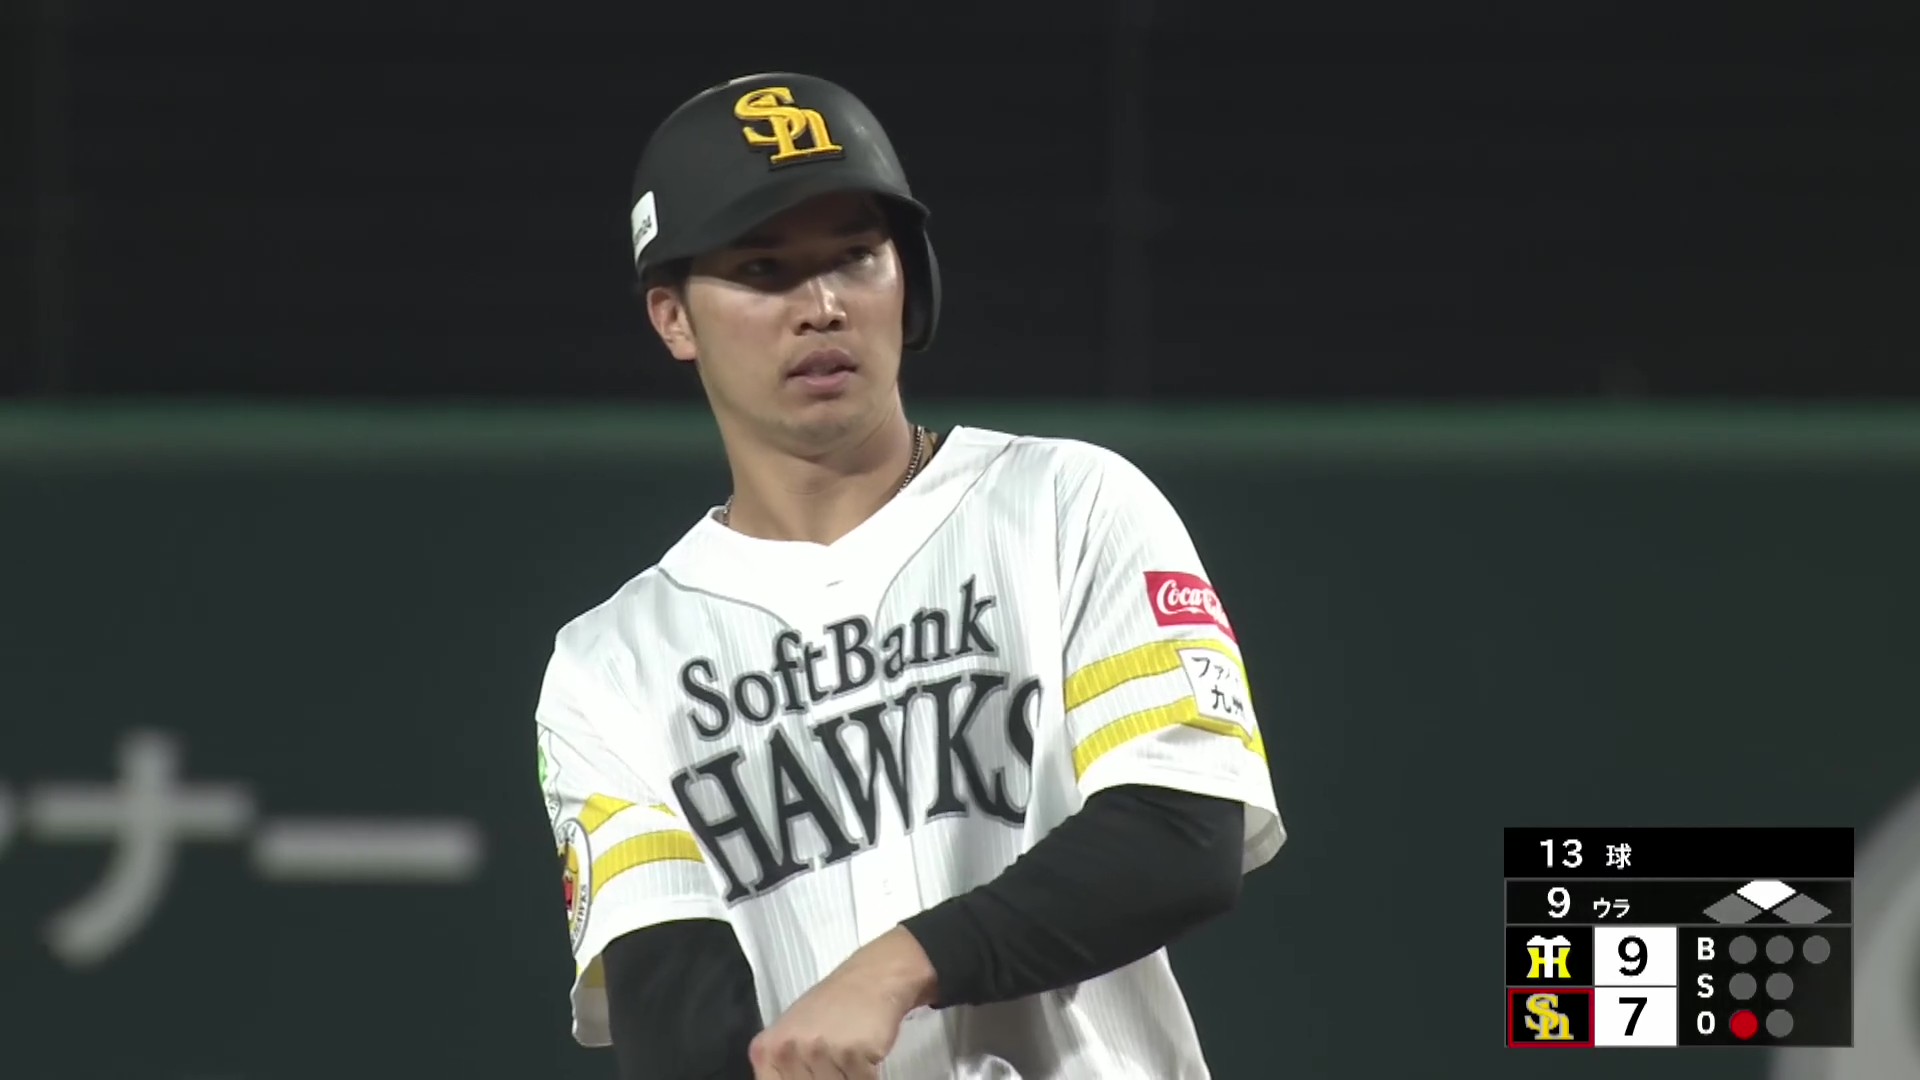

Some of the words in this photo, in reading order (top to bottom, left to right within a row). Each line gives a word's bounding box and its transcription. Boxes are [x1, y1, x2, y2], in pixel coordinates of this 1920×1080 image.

[678, 574, 999, 740] SoftBank
[0, 730, 485, 966] ナー
[670, 670, 1043, 908] HAWKS
